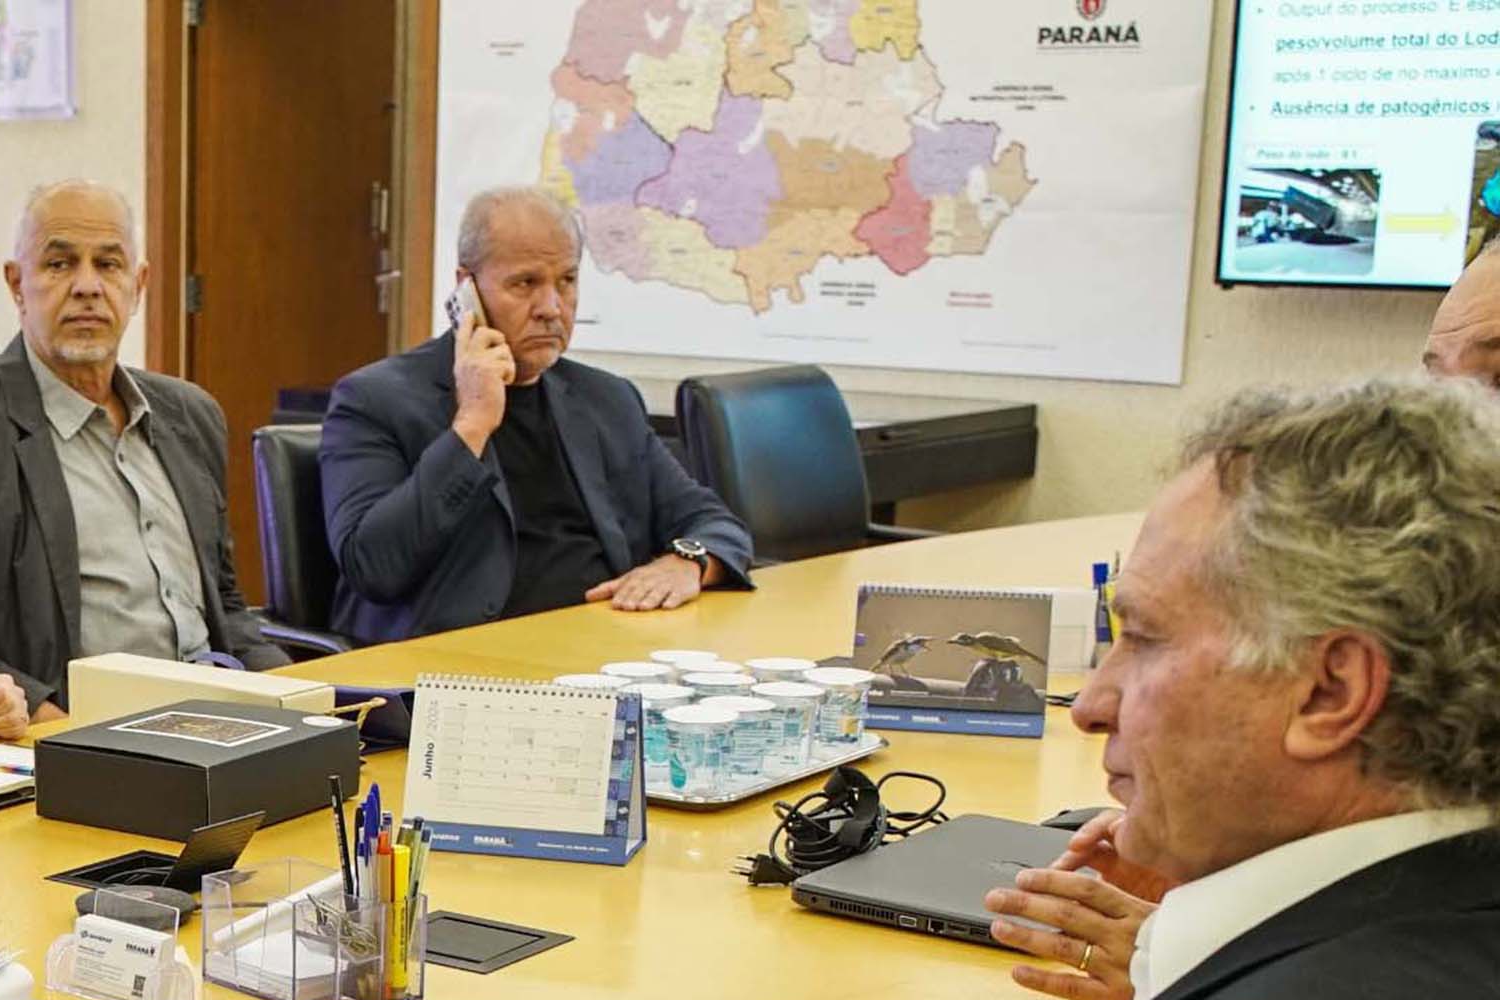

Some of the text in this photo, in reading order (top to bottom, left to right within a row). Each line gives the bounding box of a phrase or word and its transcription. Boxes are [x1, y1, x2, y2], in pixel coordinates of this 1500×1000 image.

[1038, 20, 1139, 44] PARANÁ
[1391, 32, 1430, 47] total
[1436, 32, 1458, 46] do
[1465, 30, 1500, 46] Lod
[1271, 98, 1490, 117] Ausência de patogênicos
[422, 742, 435, 779] Junho
